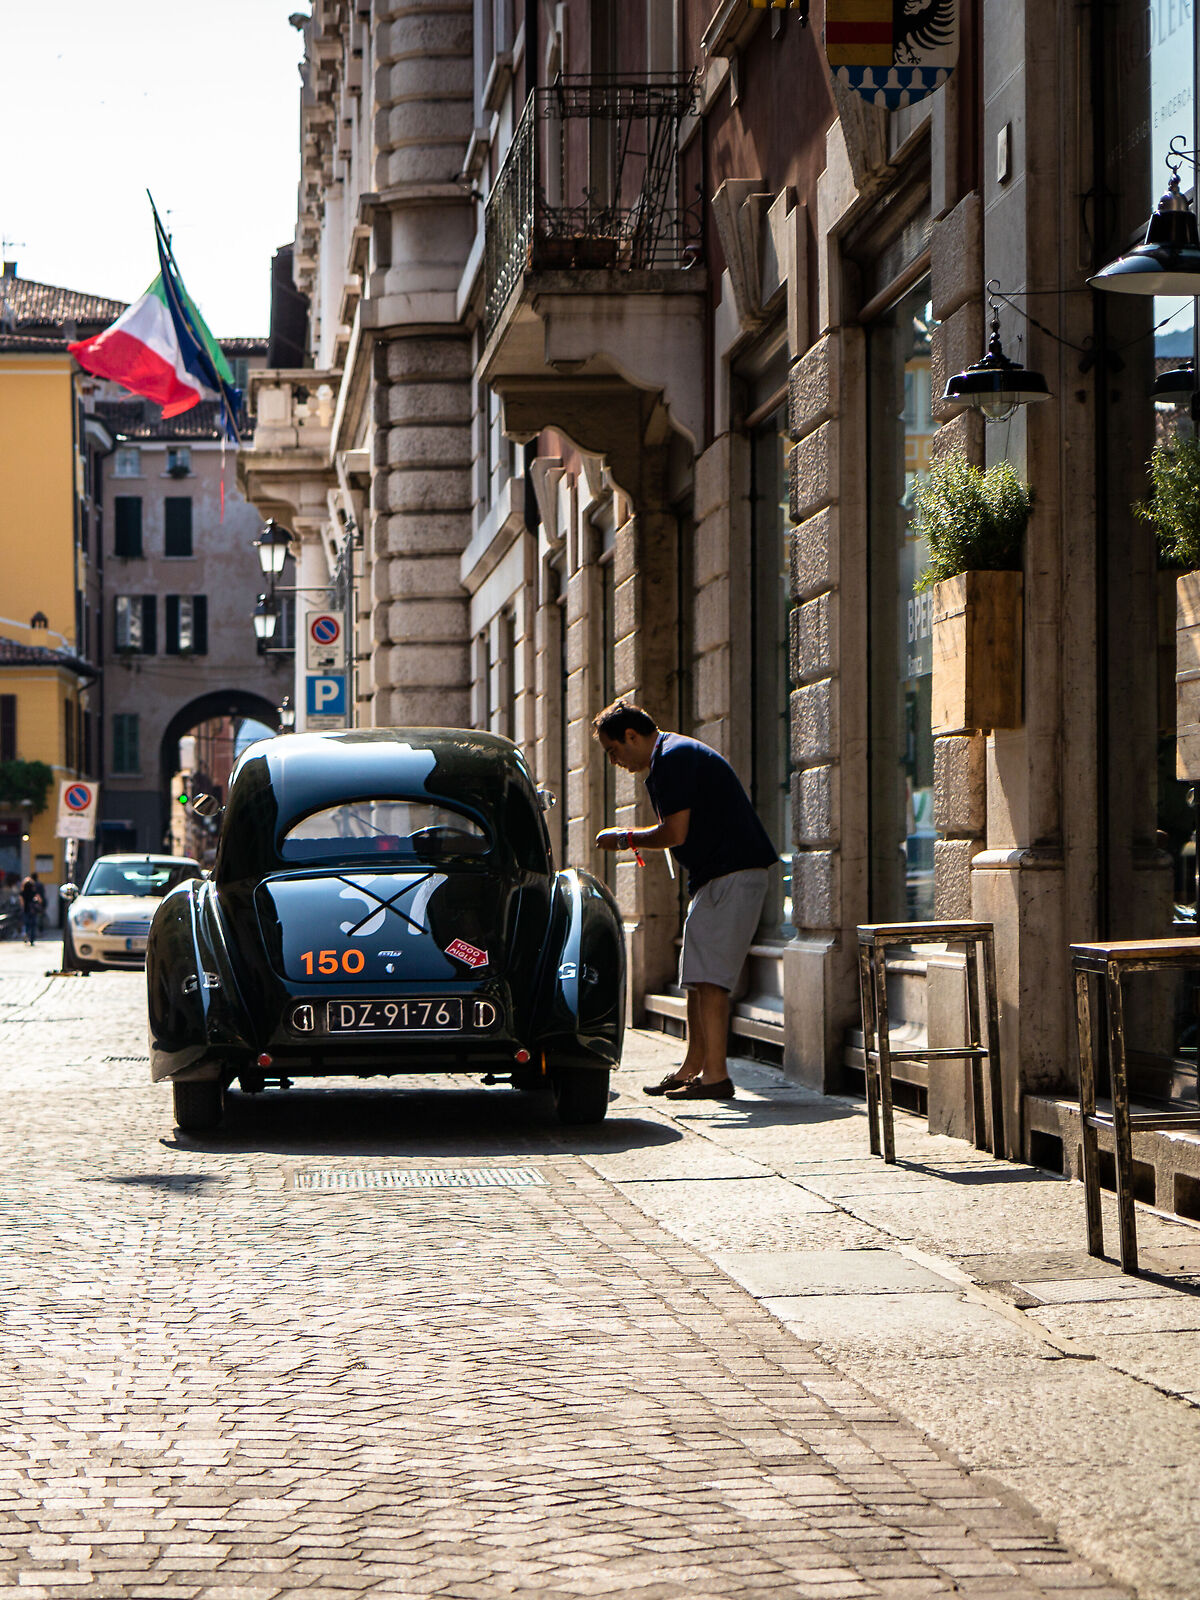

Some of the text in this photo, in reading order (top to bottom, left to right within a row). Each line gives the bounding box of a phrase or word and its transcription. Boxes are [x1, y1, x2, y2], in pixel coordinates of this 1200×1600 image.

[315, 680, 339, 710] P
[300, 949, 365, 975] 150
[449, 948, 477, 965] MIGLIA
[456, 942, 481, 957] 1000
[340, 1002, 450, 1027] DZ-91-76
